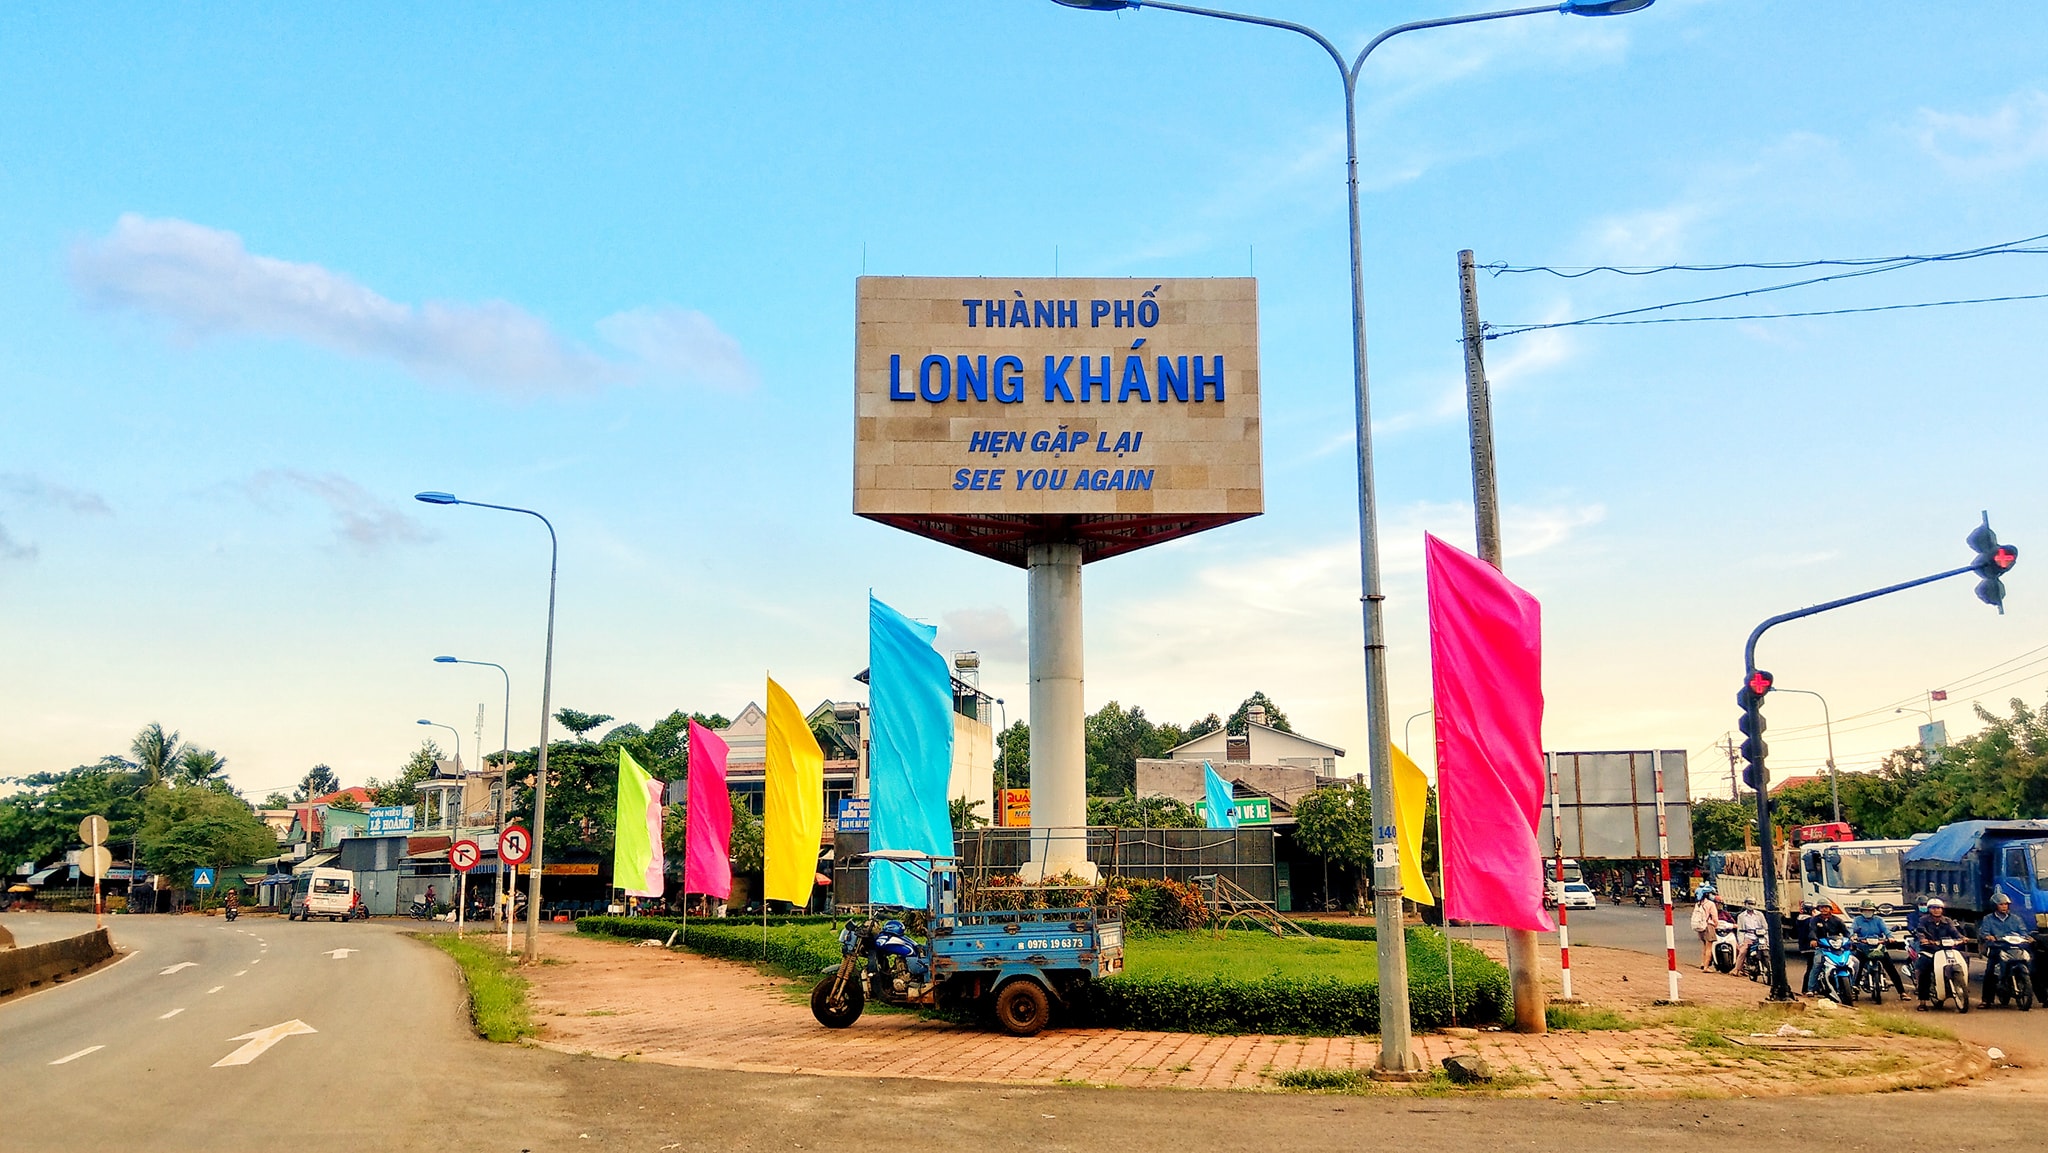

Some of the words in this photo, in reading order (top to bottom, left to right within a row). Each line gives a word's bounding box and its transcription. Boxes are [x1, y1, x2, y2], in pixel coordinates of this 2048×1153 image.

[962, 290, 1078, 328] THÀNH
[1091, 285, 1162, 328] PHỐ
[889, 354, 1024, 403] LONG
[1044, 338, 1225, 403] KHÁNH
[968, 430, 1027, 458] HẸN
[1031, 425, 1089, 458] GẶP
[1096, 430, 1143, 458] LẠI
[953, 468, 1004, 491] SEE
[1016, 468, 1069, 491] YOU
[1073, 468, 1154, 491] AGAIN
[1243, 803, 1255, 819] VÉ
[1256, 804, 1267, 818] XE
[1378, 825, 1397, 839] 140
[1376, 848, 1384, 863] 8
[1027, 939, 1048, 949] 0976
[1050, 939, 1060, 949] 19
[1061, 938, 1071, 948] 63
[1072, 938, 1083, 948] 73
